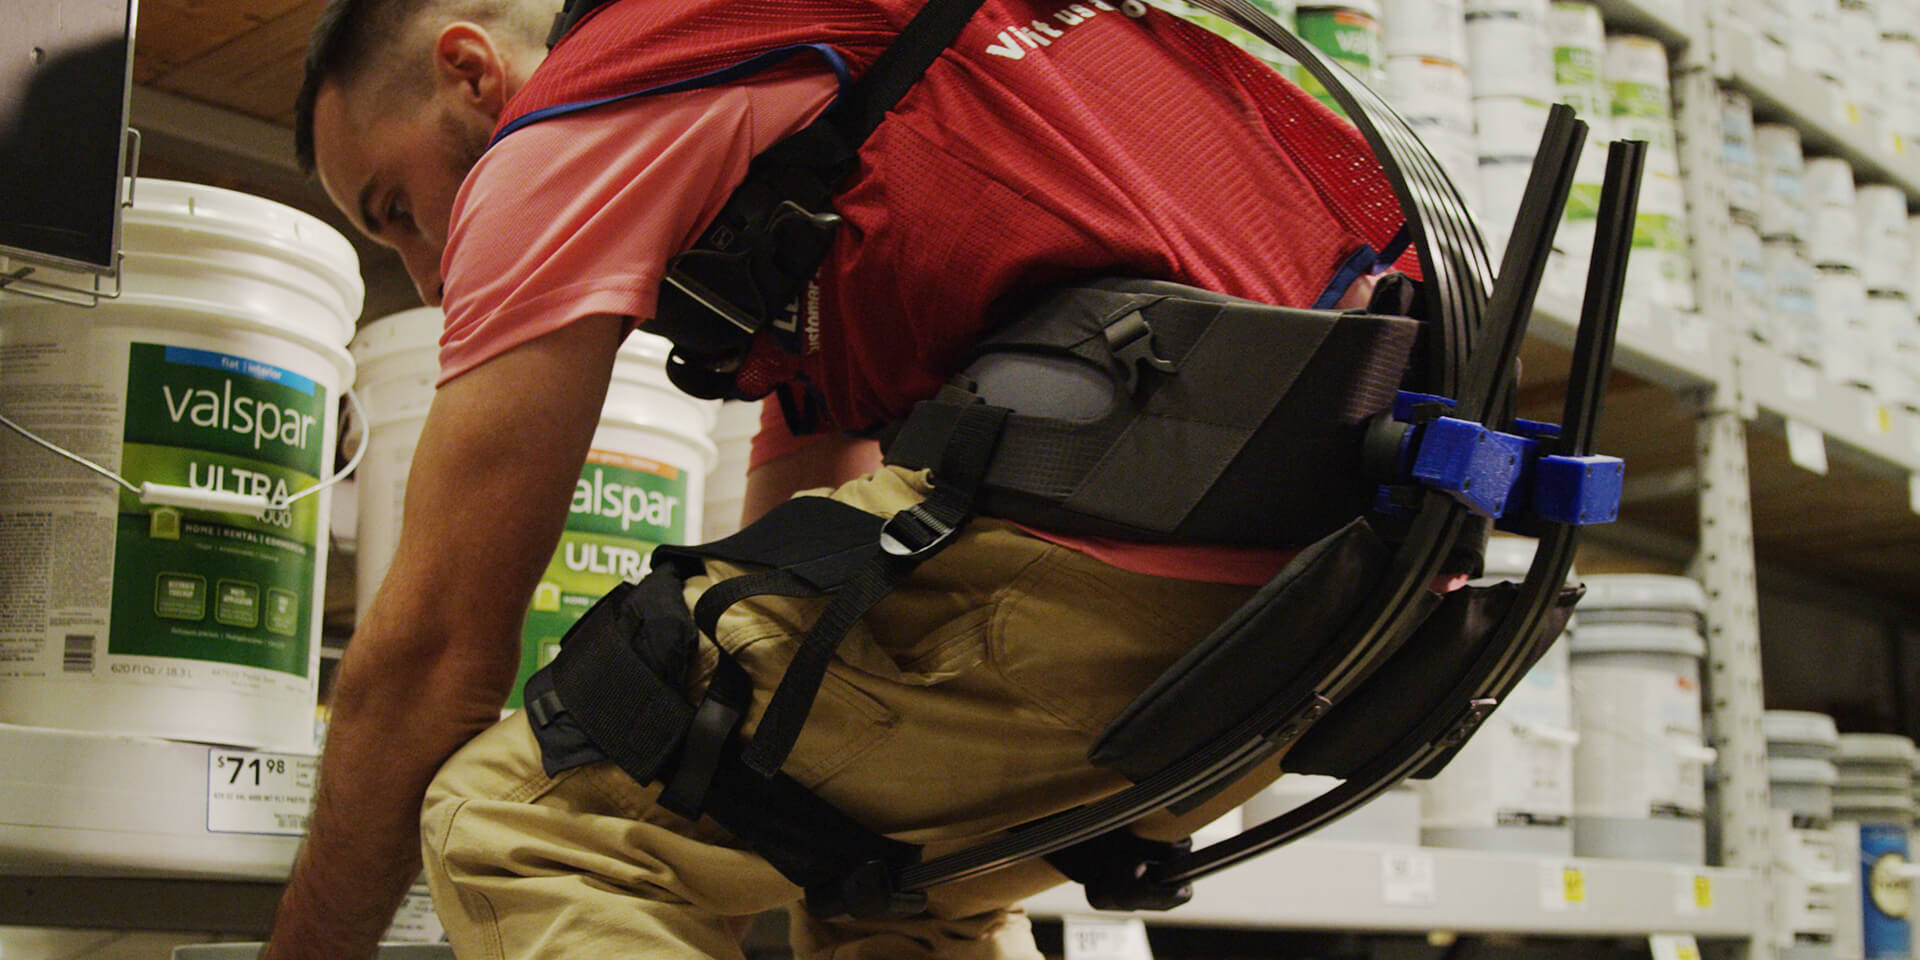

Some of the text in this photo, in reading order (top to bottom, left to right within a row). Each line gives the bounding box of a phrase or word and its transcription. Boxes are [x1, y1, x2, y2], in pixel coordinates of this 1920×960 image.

[1053, 4, 1096, 26] us
[163, 379, 316, 449] valspar
[189, 462, 289, 507] ULTRA
[569, 468, 681, 531] alspar
[110, 663, 130, 674] 620
